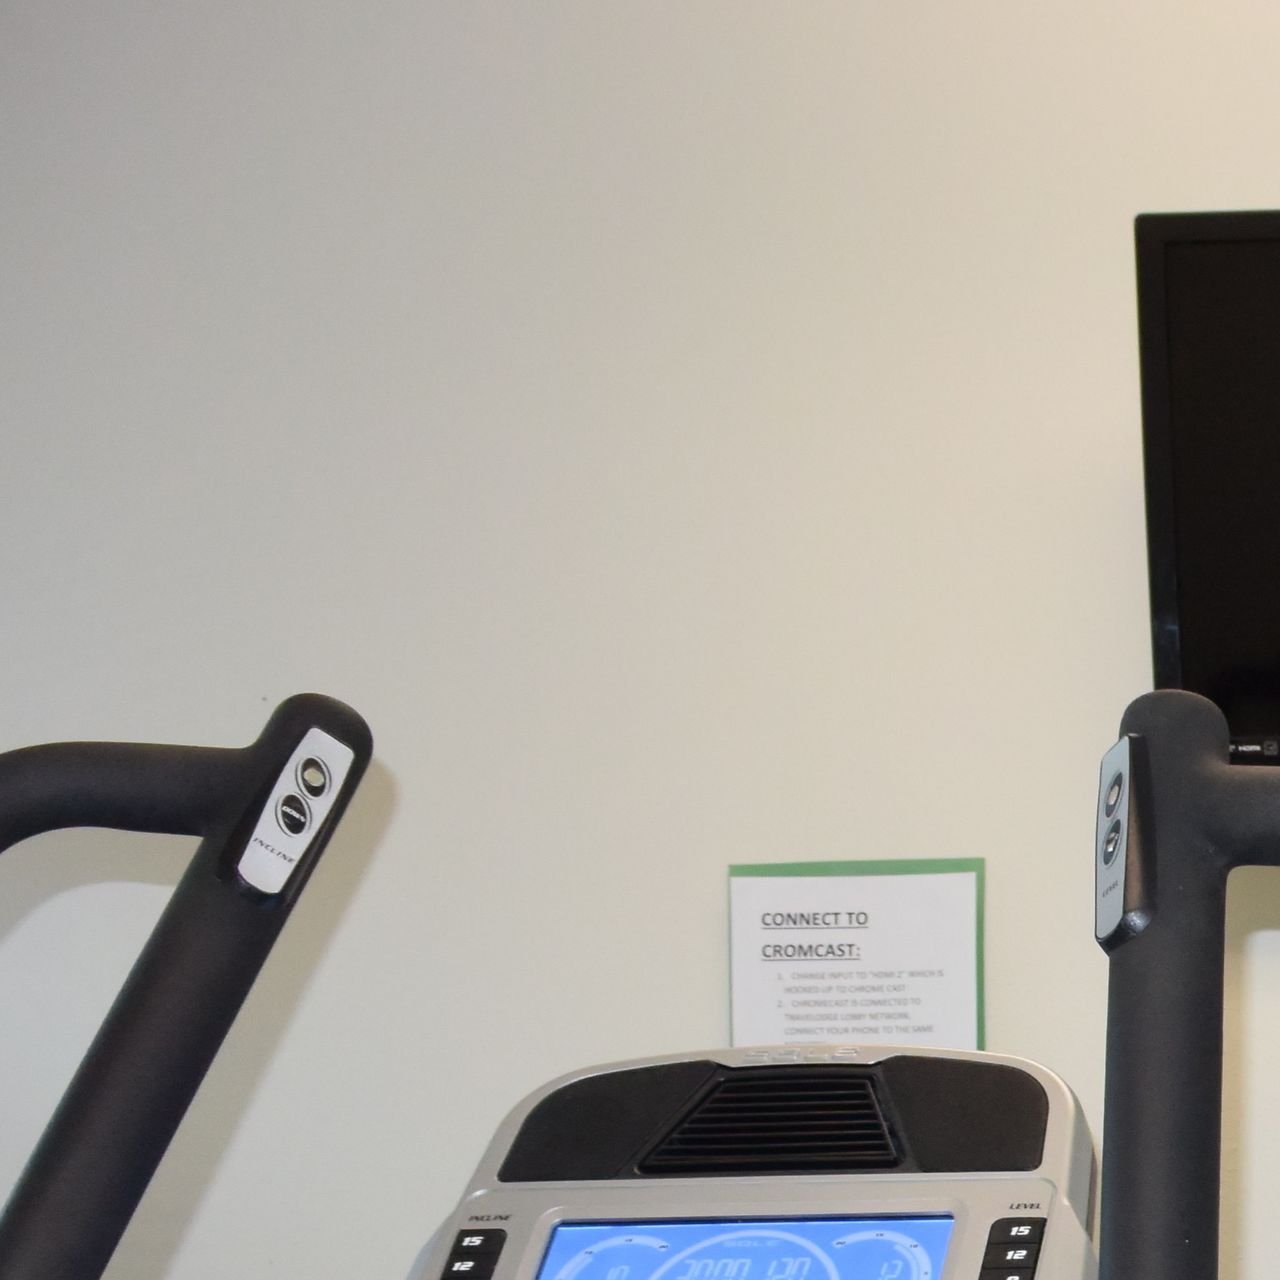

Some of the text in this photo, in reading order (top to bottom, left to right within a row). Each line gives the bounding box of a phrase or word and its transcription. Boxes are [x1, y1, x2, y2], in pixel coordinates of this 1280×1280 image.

[761, 912, 868, 926] CONNECT TO
[761, 944, 861, 958] CROMCAST:
[468, 1214, 511, 1222] INCLINE
[1009, 1226, 1032, 1236] 15
[462, 1236, 484, 1246] 15
[1005, 1250, 1027, 1260] 12
[452, 1261, 475, 1271] 12
